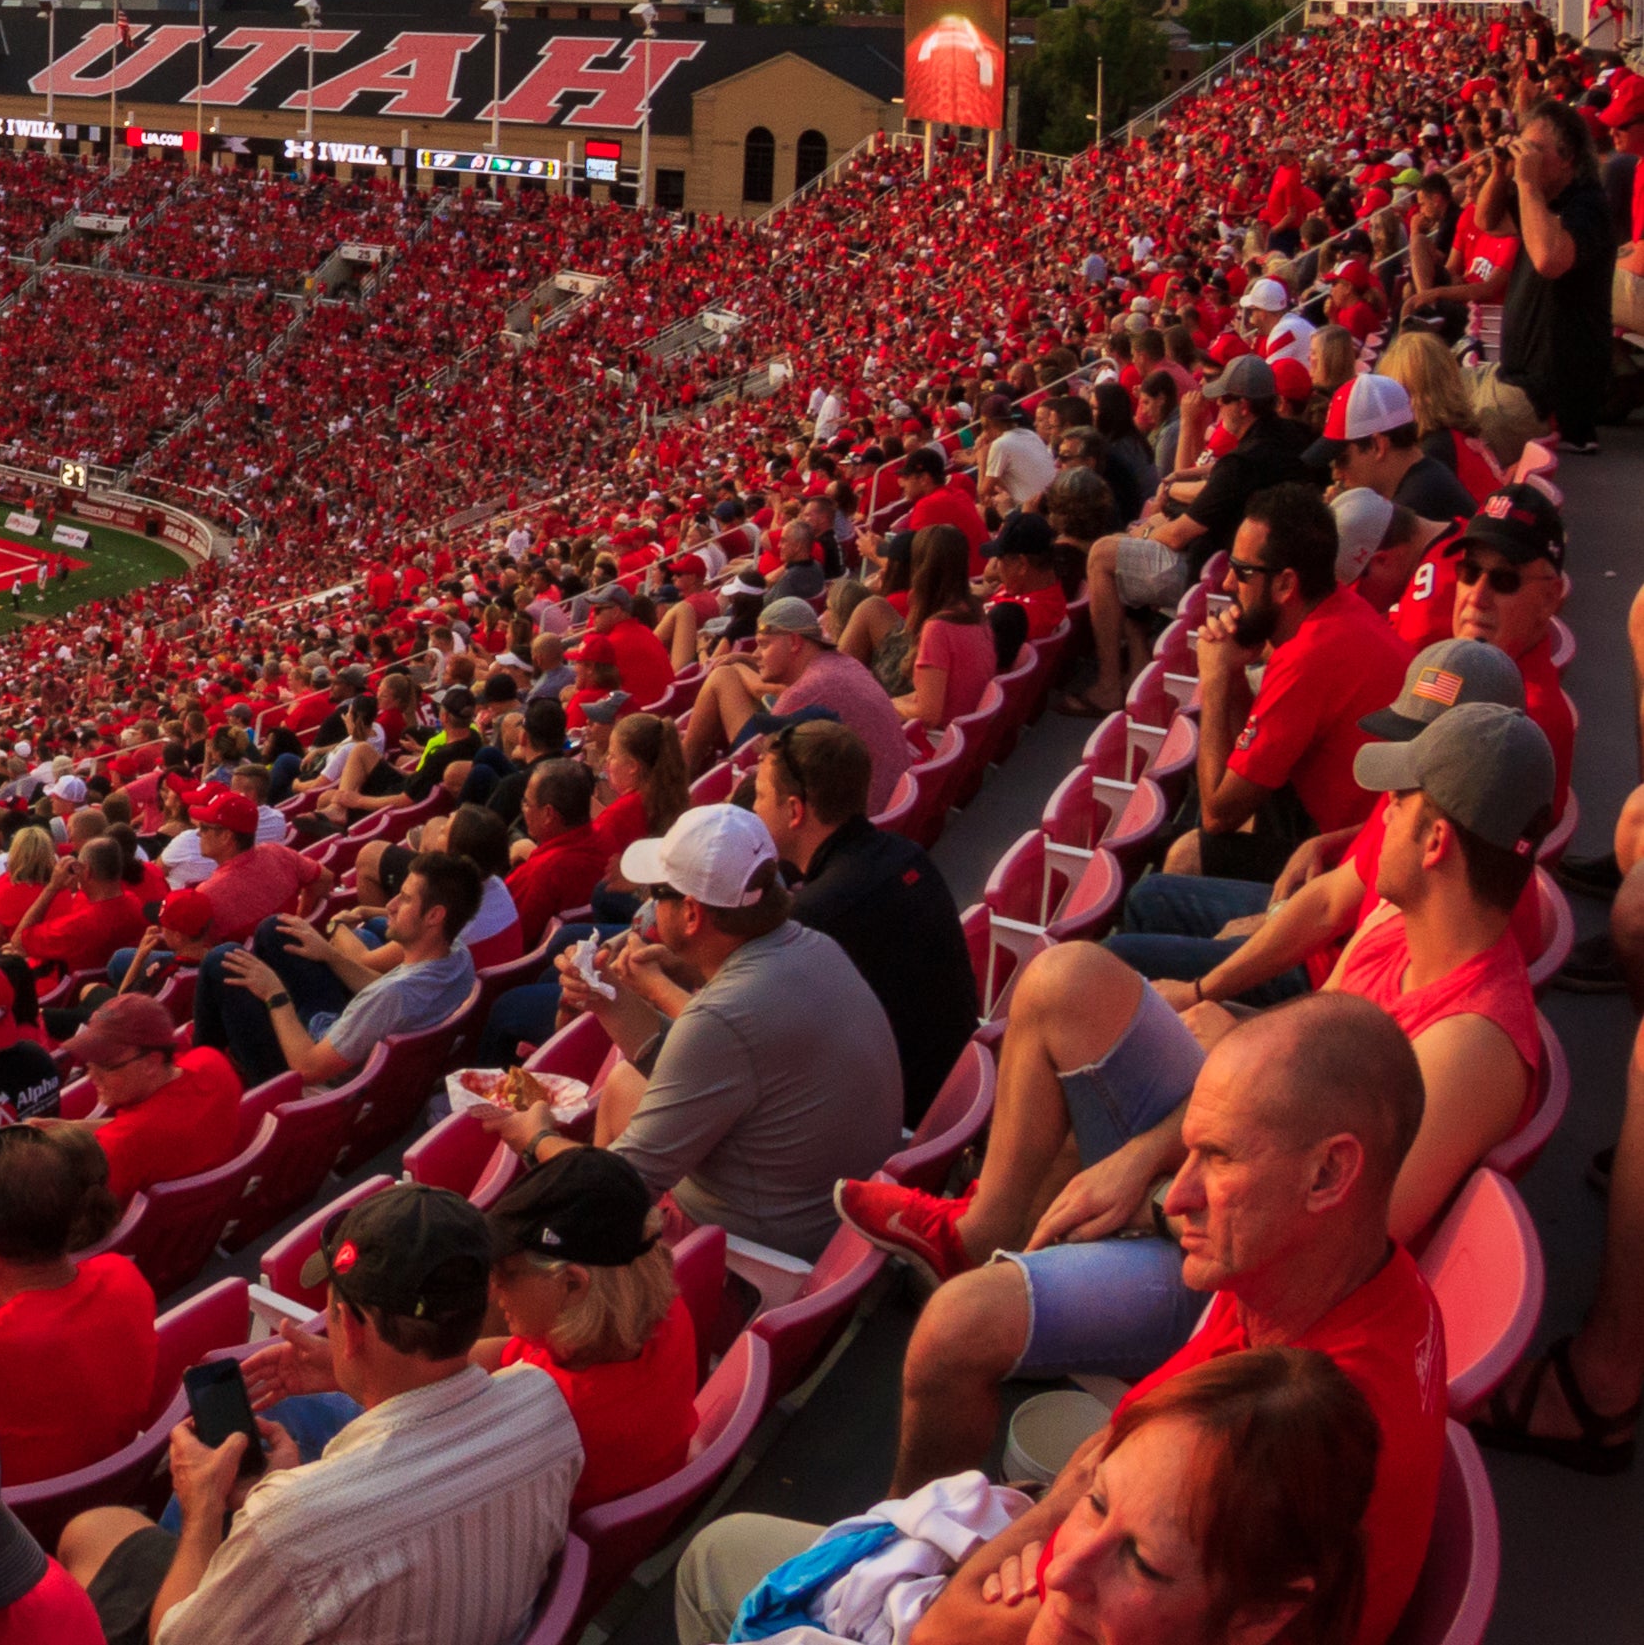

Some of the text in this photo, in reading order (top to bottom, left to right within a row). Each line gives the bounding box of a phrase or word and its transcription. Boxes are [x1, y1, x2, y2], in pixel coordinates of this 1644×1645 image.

[28, 22, 705, 130] UTAH
[6, 119, 62, 139] I WILL
[318, 142, 387, 165] I WILL
[433, 153, 456, 167] 17
[63, 463, 85, 487] 27
[1413, 562, 1436, 602] 9
[17, 1076, 59, 1110] Alpha
